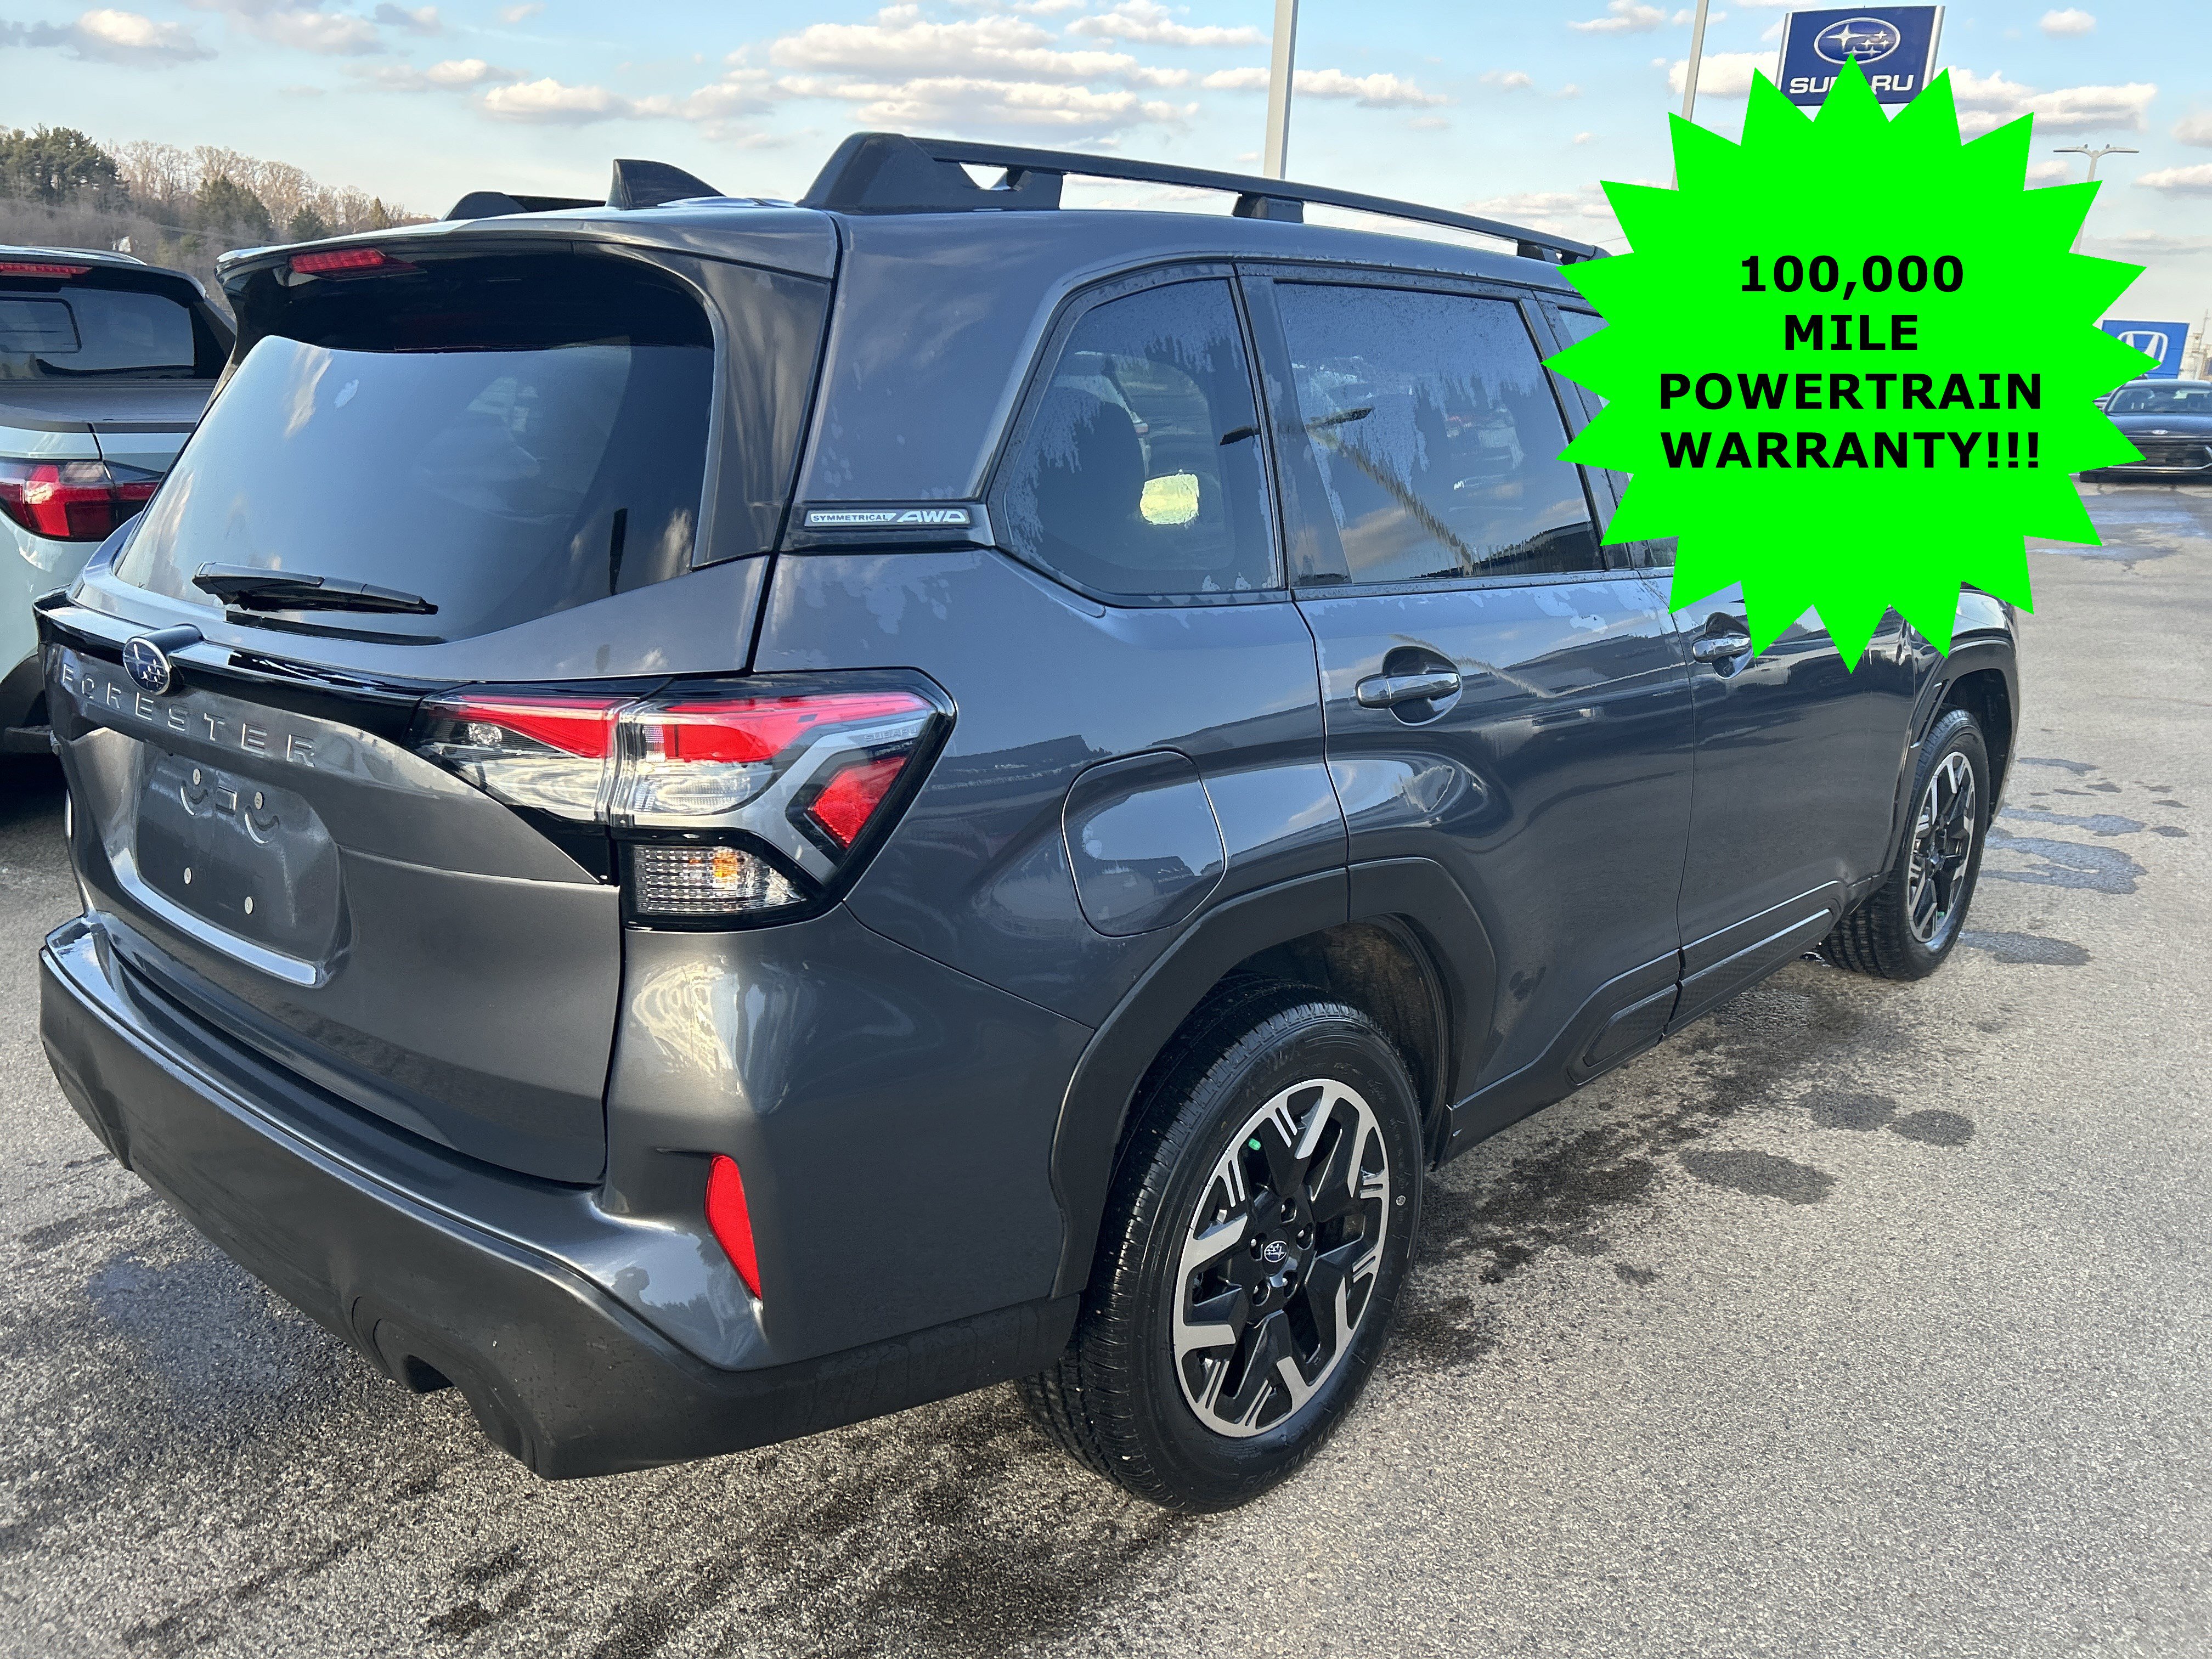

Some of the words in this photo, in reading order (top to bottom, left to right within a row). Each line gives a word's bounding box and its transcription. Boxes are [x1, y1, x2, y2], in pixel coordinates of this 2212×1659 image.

[1789, 75, 1914, 94] SURU
[813, 514, 889, 522] SYMMETRICAL
[896, 510, 967, 523] AWD
[62, 662, 317, 768] FORESTER
[864, 727, 917, 741] SUBARU
